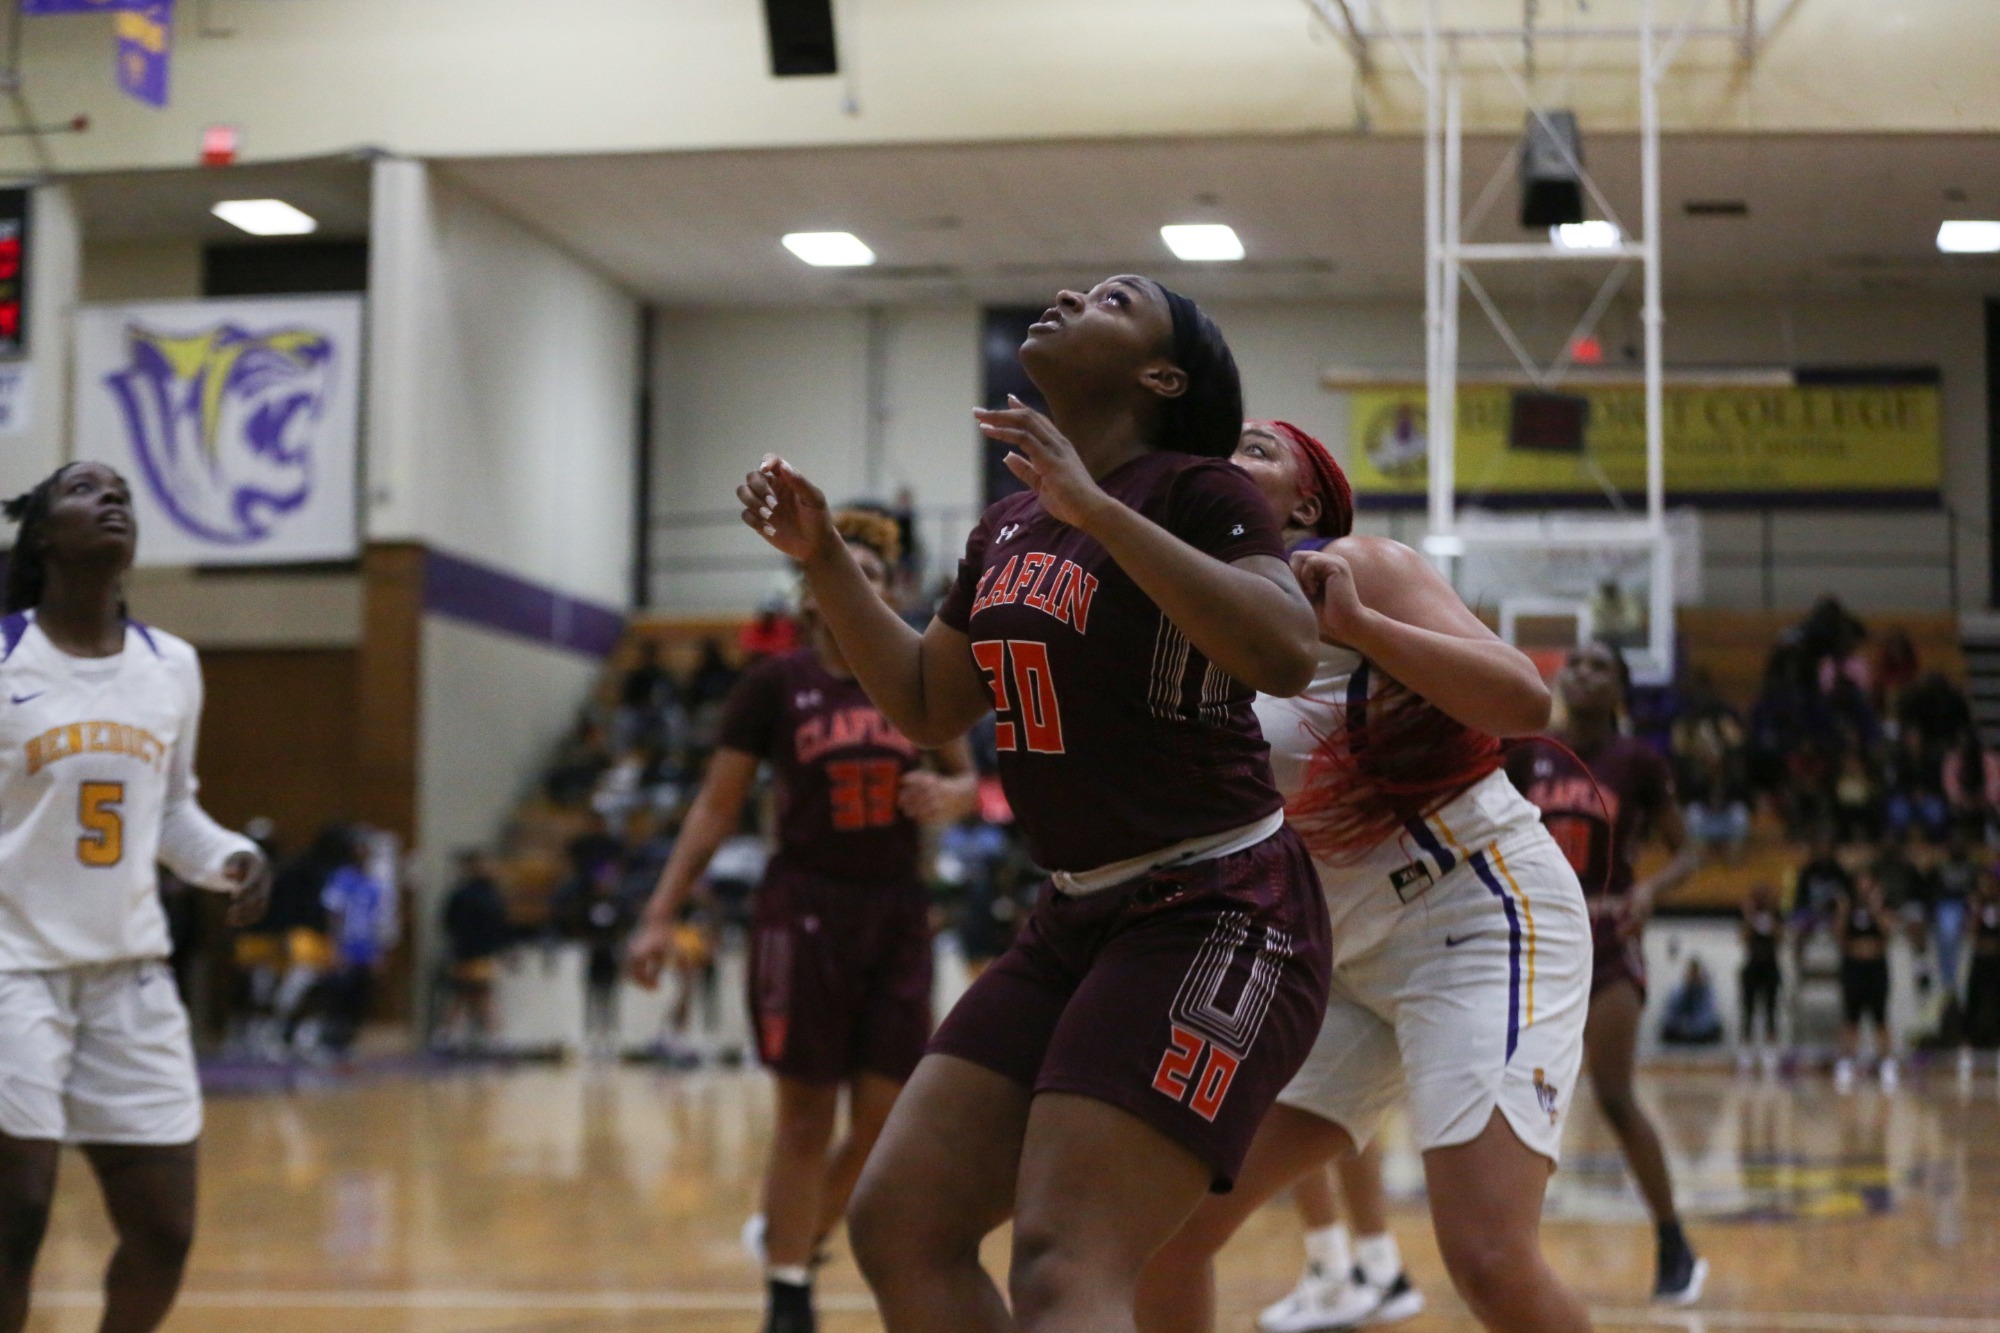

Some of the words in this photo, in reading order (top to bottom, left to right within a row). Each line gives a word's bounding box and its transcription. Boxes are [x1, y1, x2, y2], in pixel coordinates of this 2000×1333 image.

[971, 639, 1065, 754] 20
[78, 780, 123, 867] 5
[826, 760, 897, 829] 33
[1152, 1024, 1240, 1122] 20
